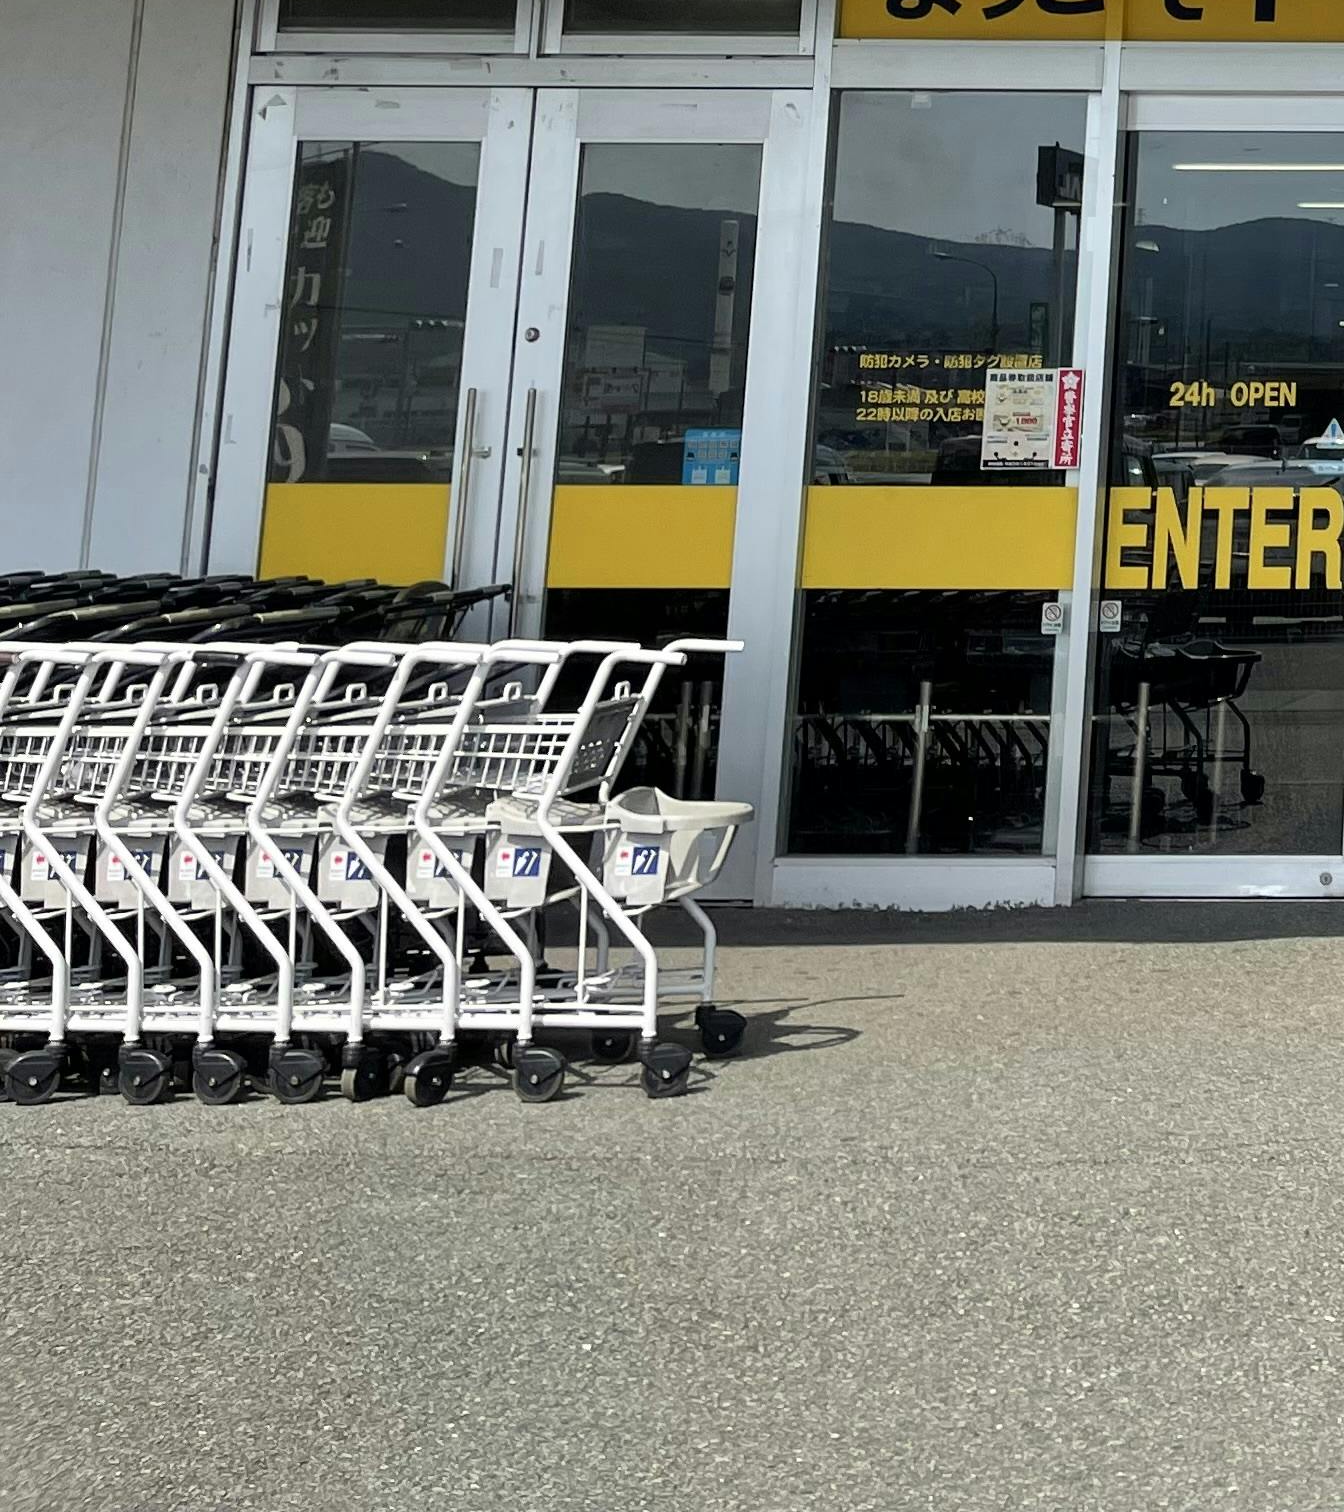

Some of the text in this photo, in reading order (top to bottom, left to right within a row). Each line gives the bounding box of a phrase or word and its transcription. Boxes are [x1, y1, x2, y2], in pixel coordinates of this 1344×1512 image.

[924, 390, 953, 405] 及び
[1169, 382, 1297, 407] 24h OPEN
[1104, 486, 1344, 590] ENTER
